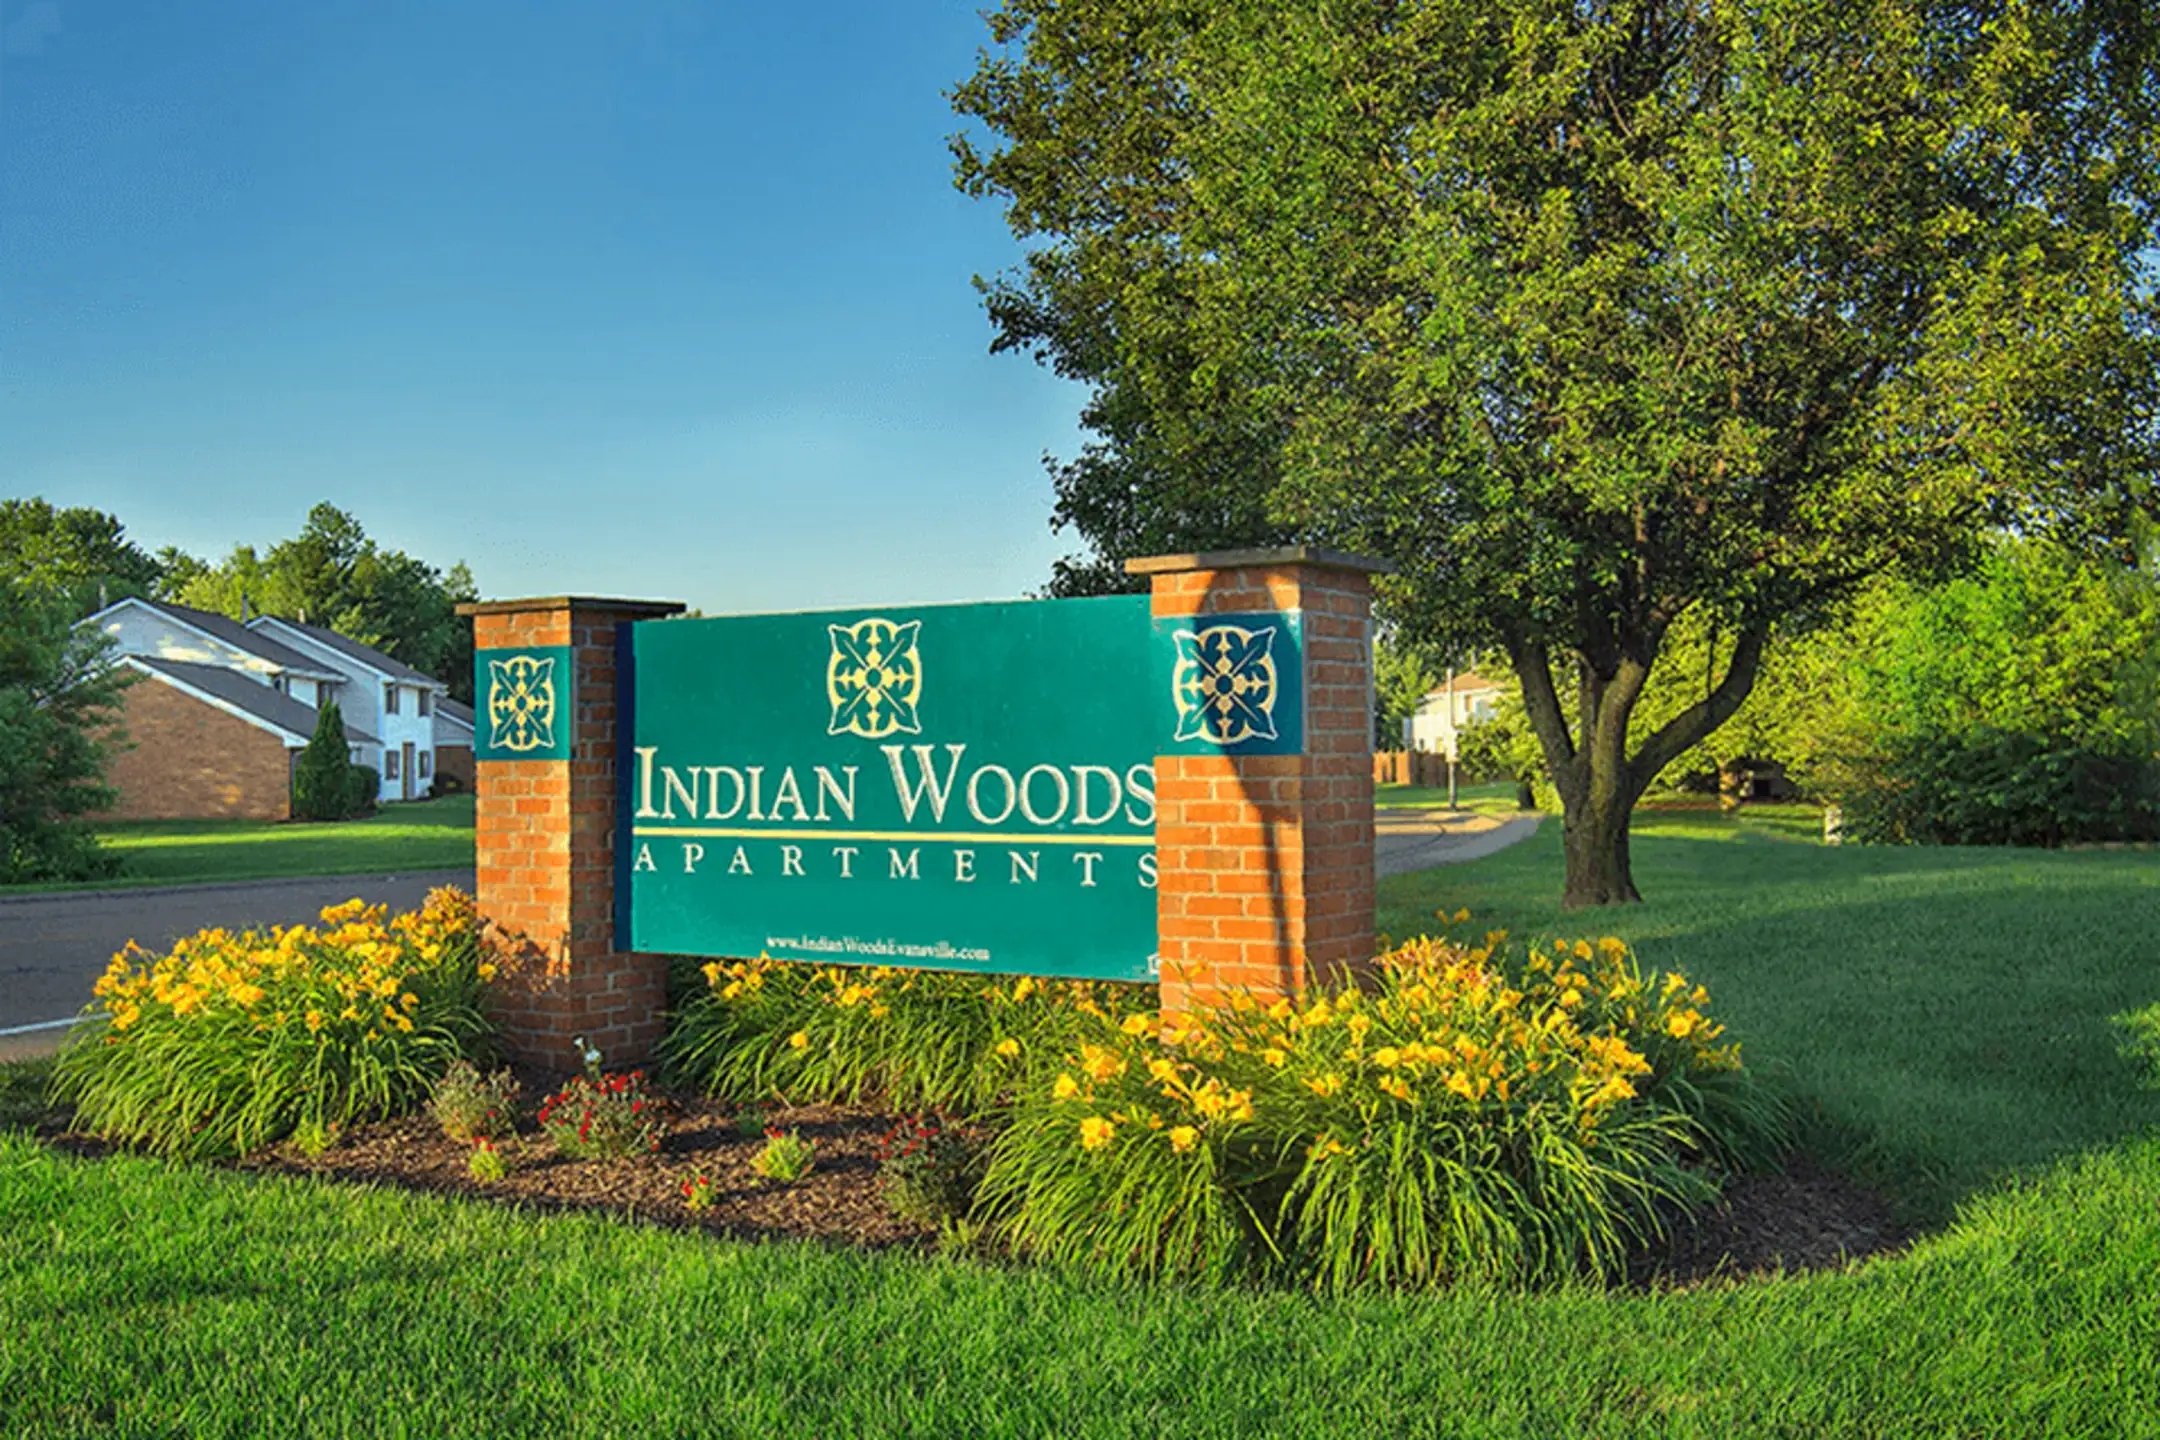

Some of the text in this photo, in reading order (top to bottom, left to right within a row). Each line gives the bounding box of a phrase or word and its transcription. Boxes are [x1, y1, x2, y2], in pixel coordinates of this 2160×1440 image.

[634, 744, 1157, 826] INDIAN WOODS
[633, 842, 1159, 888] APARTMENTS
[766, 933, 990, 961] www.IndianWoodsEvansville.com
